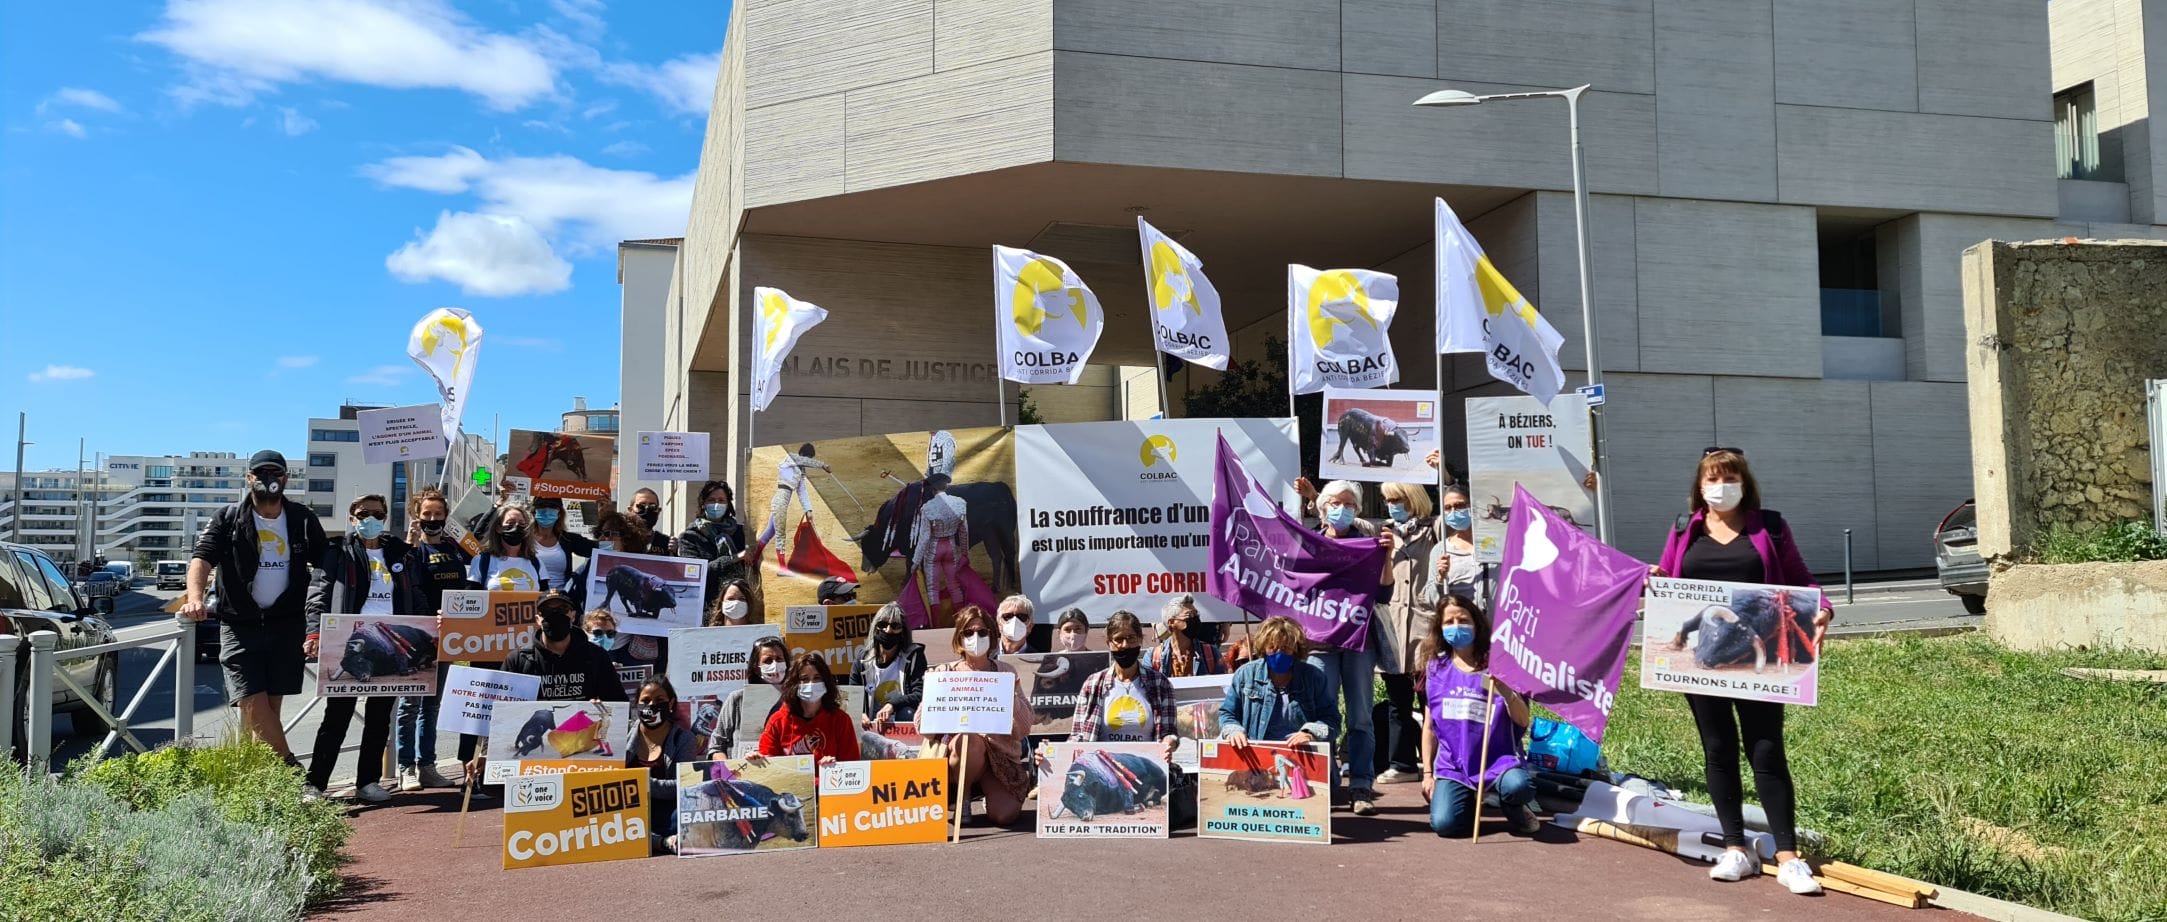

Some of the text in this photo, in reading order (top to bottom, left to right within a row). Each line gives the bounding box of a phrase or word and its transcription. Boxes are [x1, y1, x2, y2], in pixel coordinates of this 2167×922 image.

[1160, 325, 1212, 349] OLBAC
[1014, 351, 1079, 367] COLBA
[780, 355, 999, 383] ALAIS DE JUSTICE
[1498, 412, 1557, 429] À BÉZIERS,
[1507, 435, 1522, 449] ON
[1526, 435, 1546, 448] TUE
[1140, 471, 1178, 480] COLBAC
[1030, 503, 1210, 528] La souffrance d'un
[1031, 532, 1210, 553] est plus importante qu'un
[1230, 523, 1288, 573] Parti
[433, 571, 459, 580] CORRI
[1093, 572, 1207, 595] STOP CORRI
[1217, 552, 1369, 626] Animaliste
[1655, 581, 1725, 593] LA CORRIDA
[366, 592, 391, 600] LBAC
[1654, 590, 1729, 603] EST CRUELLE
[496, 603, 534, 624] STO
[1504, 583, 1541, 638] Parti
[833, 616, 870, 640] STO
[442, 625, 535, 656] Corrid
[701, 651, 749, 665] À BÉZIERS,
[1490, 618, 1614, 717] Animaliste
[621, 671, 644, 681] NIE
[691, 671, 703, 683] ON
[949, 676, 999, 684] SOUFFRANCE
[326, 684, 426, 693] TUÉ POUR DIVERTIR
[470, 680, 509, 691] CORRIDAS
[1655, 672, 1728, 688] TOURNONS
[1732, 680, 1749, 690] LA
[1753, 683, 1790, 695] PAGE
[451, 688, 477, 698] NOTRE
[1030, 694, 1080, 706] UFFRAN
[465, 701, 480, 709] PAS
[927, 704, 947, 713] ÊTRE
[461, 711, 492, 721] TRADITI
[885, 725, 917, 736] CRUA
[1108, 733, 1144, 742] COLBAC
[523, 764, 621, 776] #StopCorrid
[534, 786, 548, 794] one
[844, 779, 861, 787] voice
[534, 794, 553, 802] voice
[871, 777, 942, 805] Ni Art
[572, 781, 639, 816] STOP
[680, 806, 769, 824] BARBARIE
[1228, 806, 1306, 820] MIS À MORT...
[820, 804, 944, 837] Ni Culture
[1044, 823, 1162, 834] TUÉ PAR "TRADITION"
[1207, 821, 1320, 835] POUR QUEL CRIME ?
[507, 813, 646, 861] Corrida
